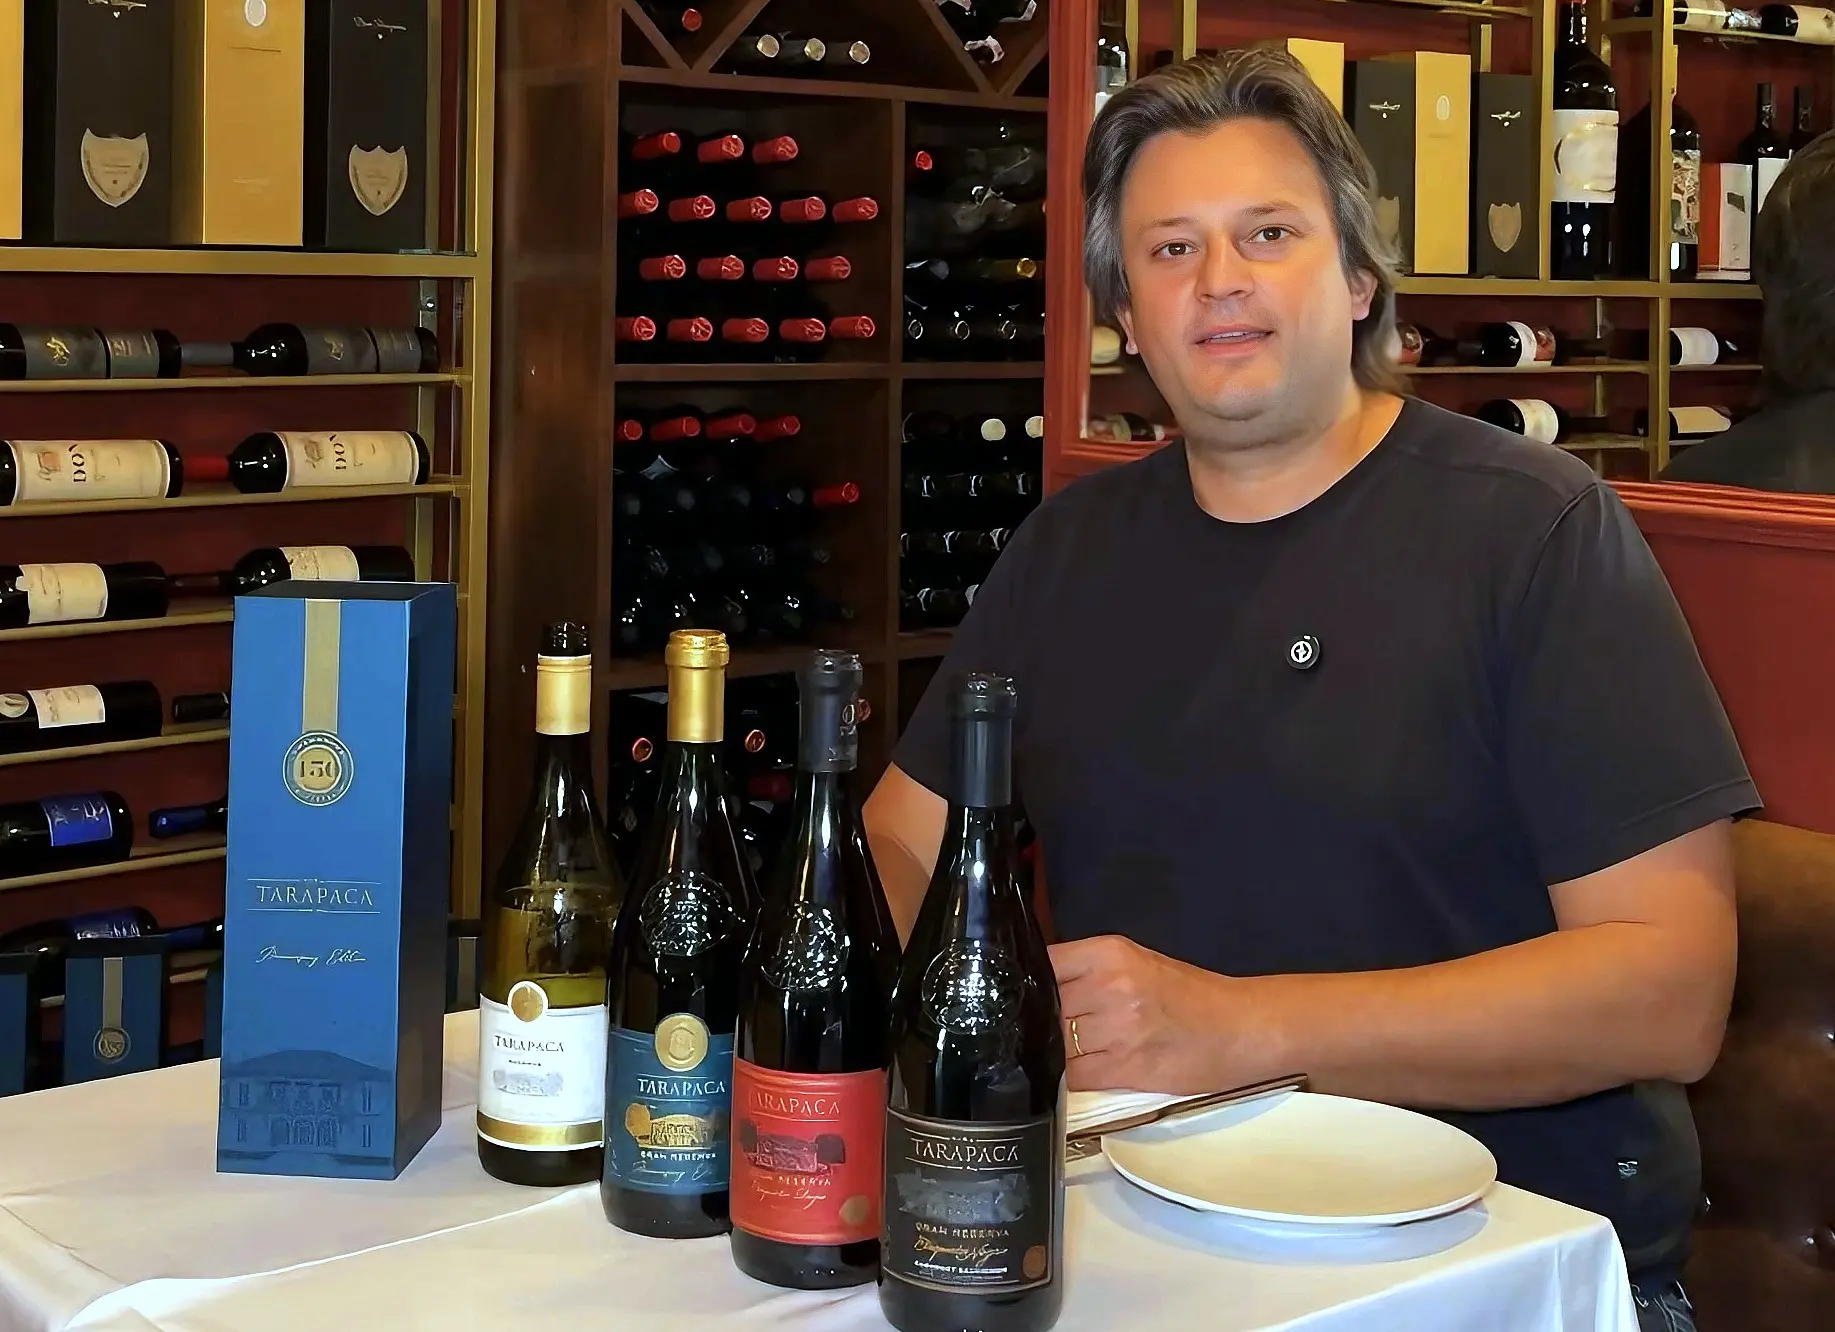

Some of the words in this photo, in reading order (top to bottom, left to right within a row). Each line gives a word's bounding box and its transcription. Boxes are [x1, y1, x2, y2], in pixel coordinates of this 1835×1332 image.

[256, 885, 374, 906] TARAPACA
[637, 1078, 727, 1097] TARAPACA
[909, 1137, 1019, 1163] TARAPACA
